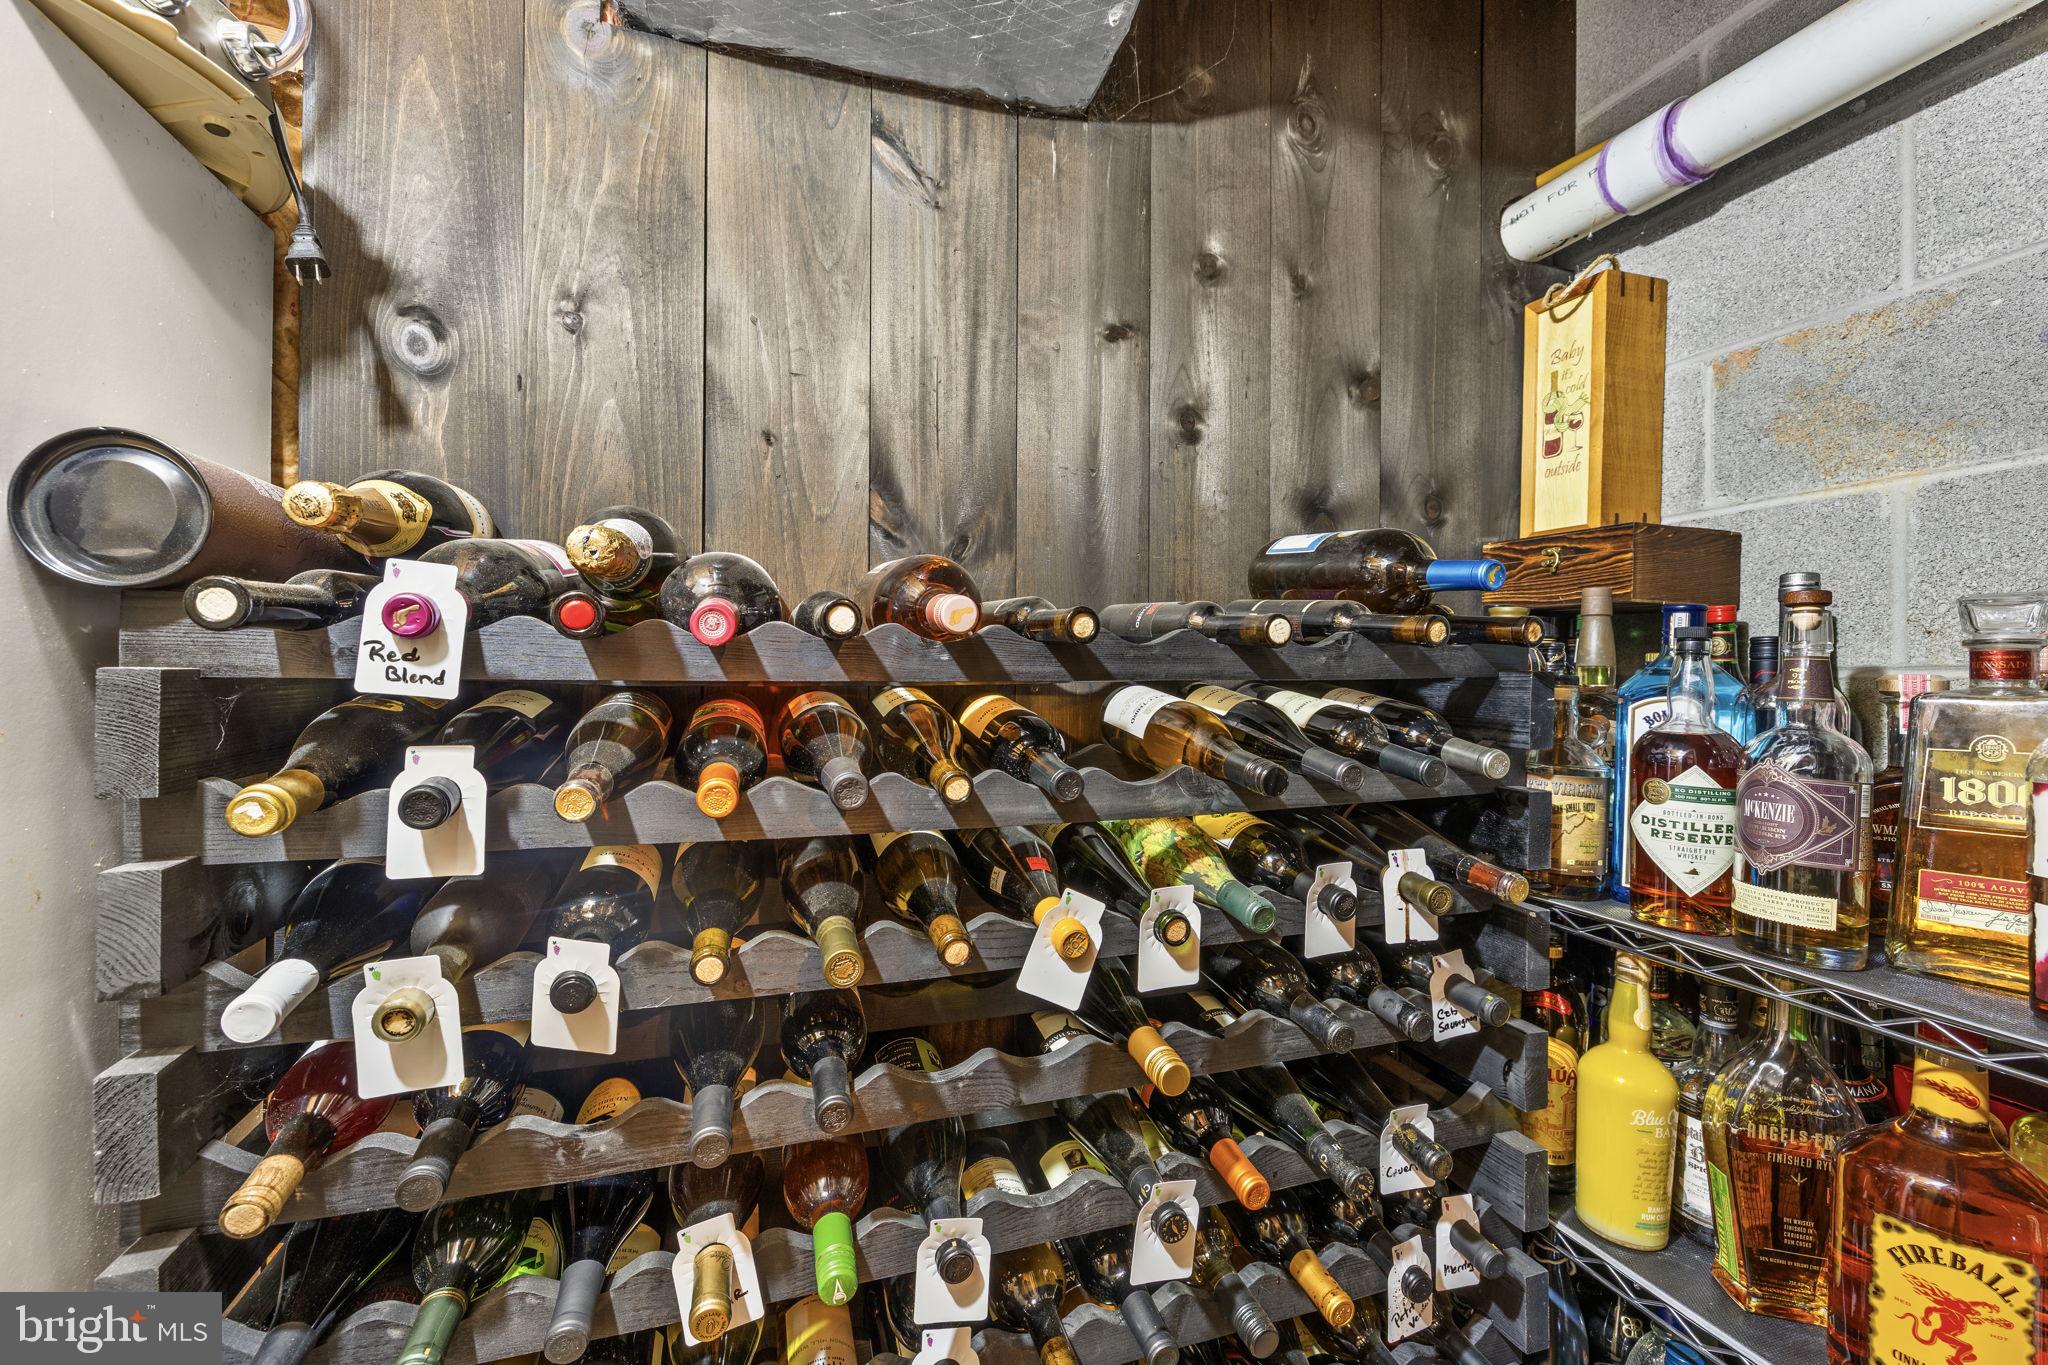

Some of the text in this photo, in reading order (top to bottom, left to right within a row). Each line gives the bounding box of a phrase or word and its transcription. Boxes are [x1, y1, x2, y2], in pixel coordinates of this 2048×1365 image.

[1510, 203, 1537, 225] NOT
[1547, 180, 1578, 202] FOR
[1550, 340, 1584, 366] Baby
[1561, 369, 1573, 380] it's
[1566, 373, 1589, 393] cold
[1545, 453, 1581, 478] outside
[363, 640, 420, 662] Red
[385, 665, 446, 686] Blend
[1993, 770, 2024, 778] RESERV
[1566, 803, 1580, 812] SMALL
[1663, 809, 1724, 821] BOTTLED-IN-BOND
[1950, 809, 2027, 822] REPOSAD
[1651, 828, 1733, 845] RESERVE
[1669, 845, 1701, 854] STRAIGHT
[1677, 853, 1707, 861] WHISKEY
[1958, 880, 2024, 894] 100% AGAV
[1759, 892, 1788, 901] CRAFTED
[1791, 898, 1825, 907] PRODUCT
[1764, 898, 1784, 906] LAKES
[1787, 902, 1830, 913] DISTILLING
[1437, 1006, 1457, 1020] Cab
[1548, 1066, 1577, 1090] LÚA
[1630, 1109, 1665, 1126] Blue
[1768, 1152, 1812, 1168] FINISHED
[1784, 1224, 1806, 1233] FINISHED
[1793, 1219, 1814, 1227] WHISKEY
[1784, 1231, 1813, 1241] CARIBBEAN
[1796, 1240, 1812, 1248] CASKS
[1887, 1244, 2020, 1304] FIREBALL
[1894, 1296, 1911, 1306] RED
